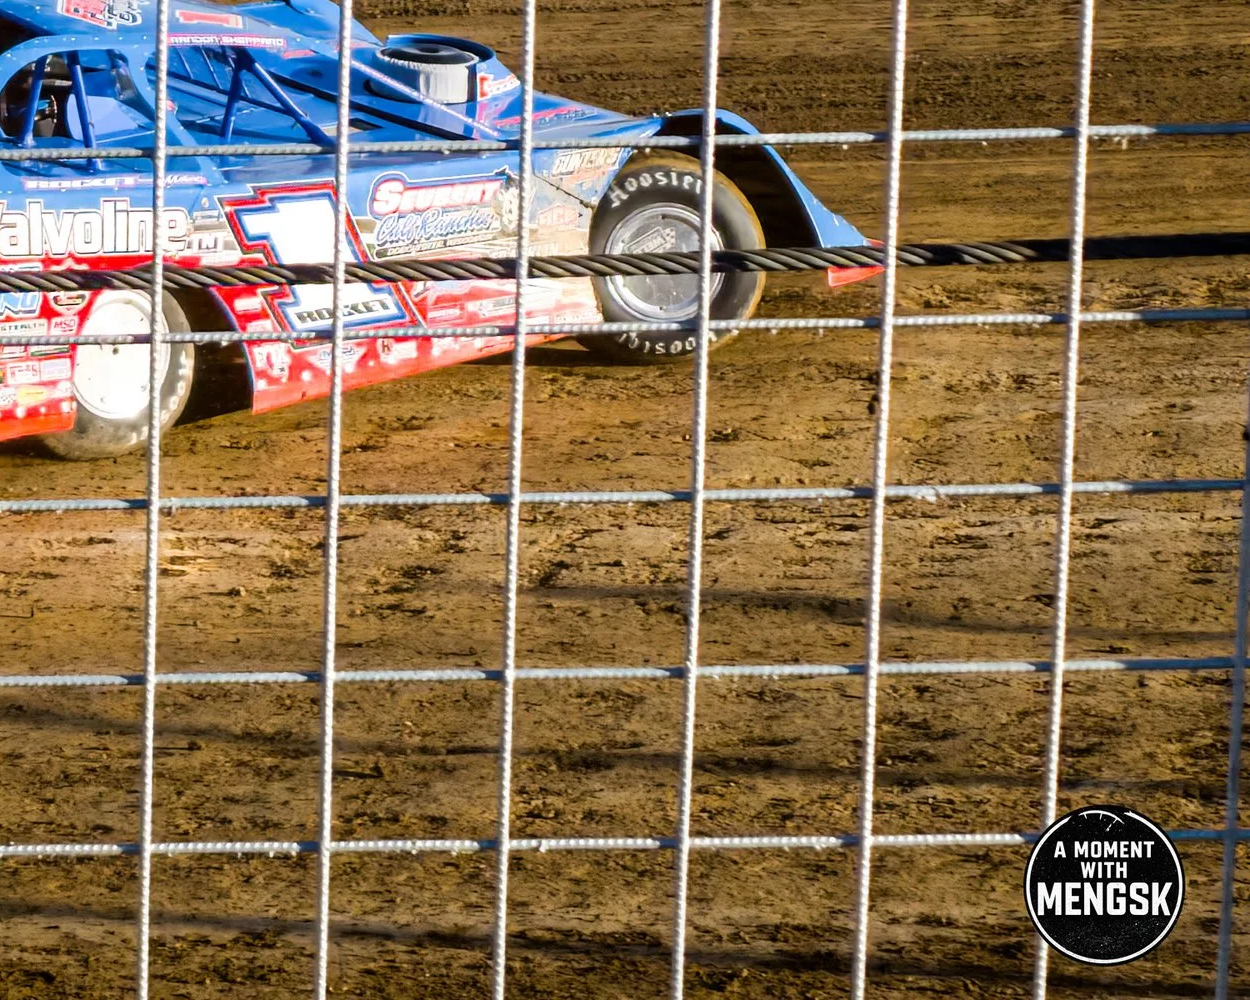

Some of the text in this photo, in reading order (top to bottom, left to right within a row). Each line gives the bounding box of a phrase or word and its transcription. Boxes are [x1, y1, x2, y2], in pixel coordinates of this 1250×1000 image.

[169, 36, 219, 46] RANDON
[372, 178, 503, 215] SEUBERT
[417, 207, 494, 242] Ranches
